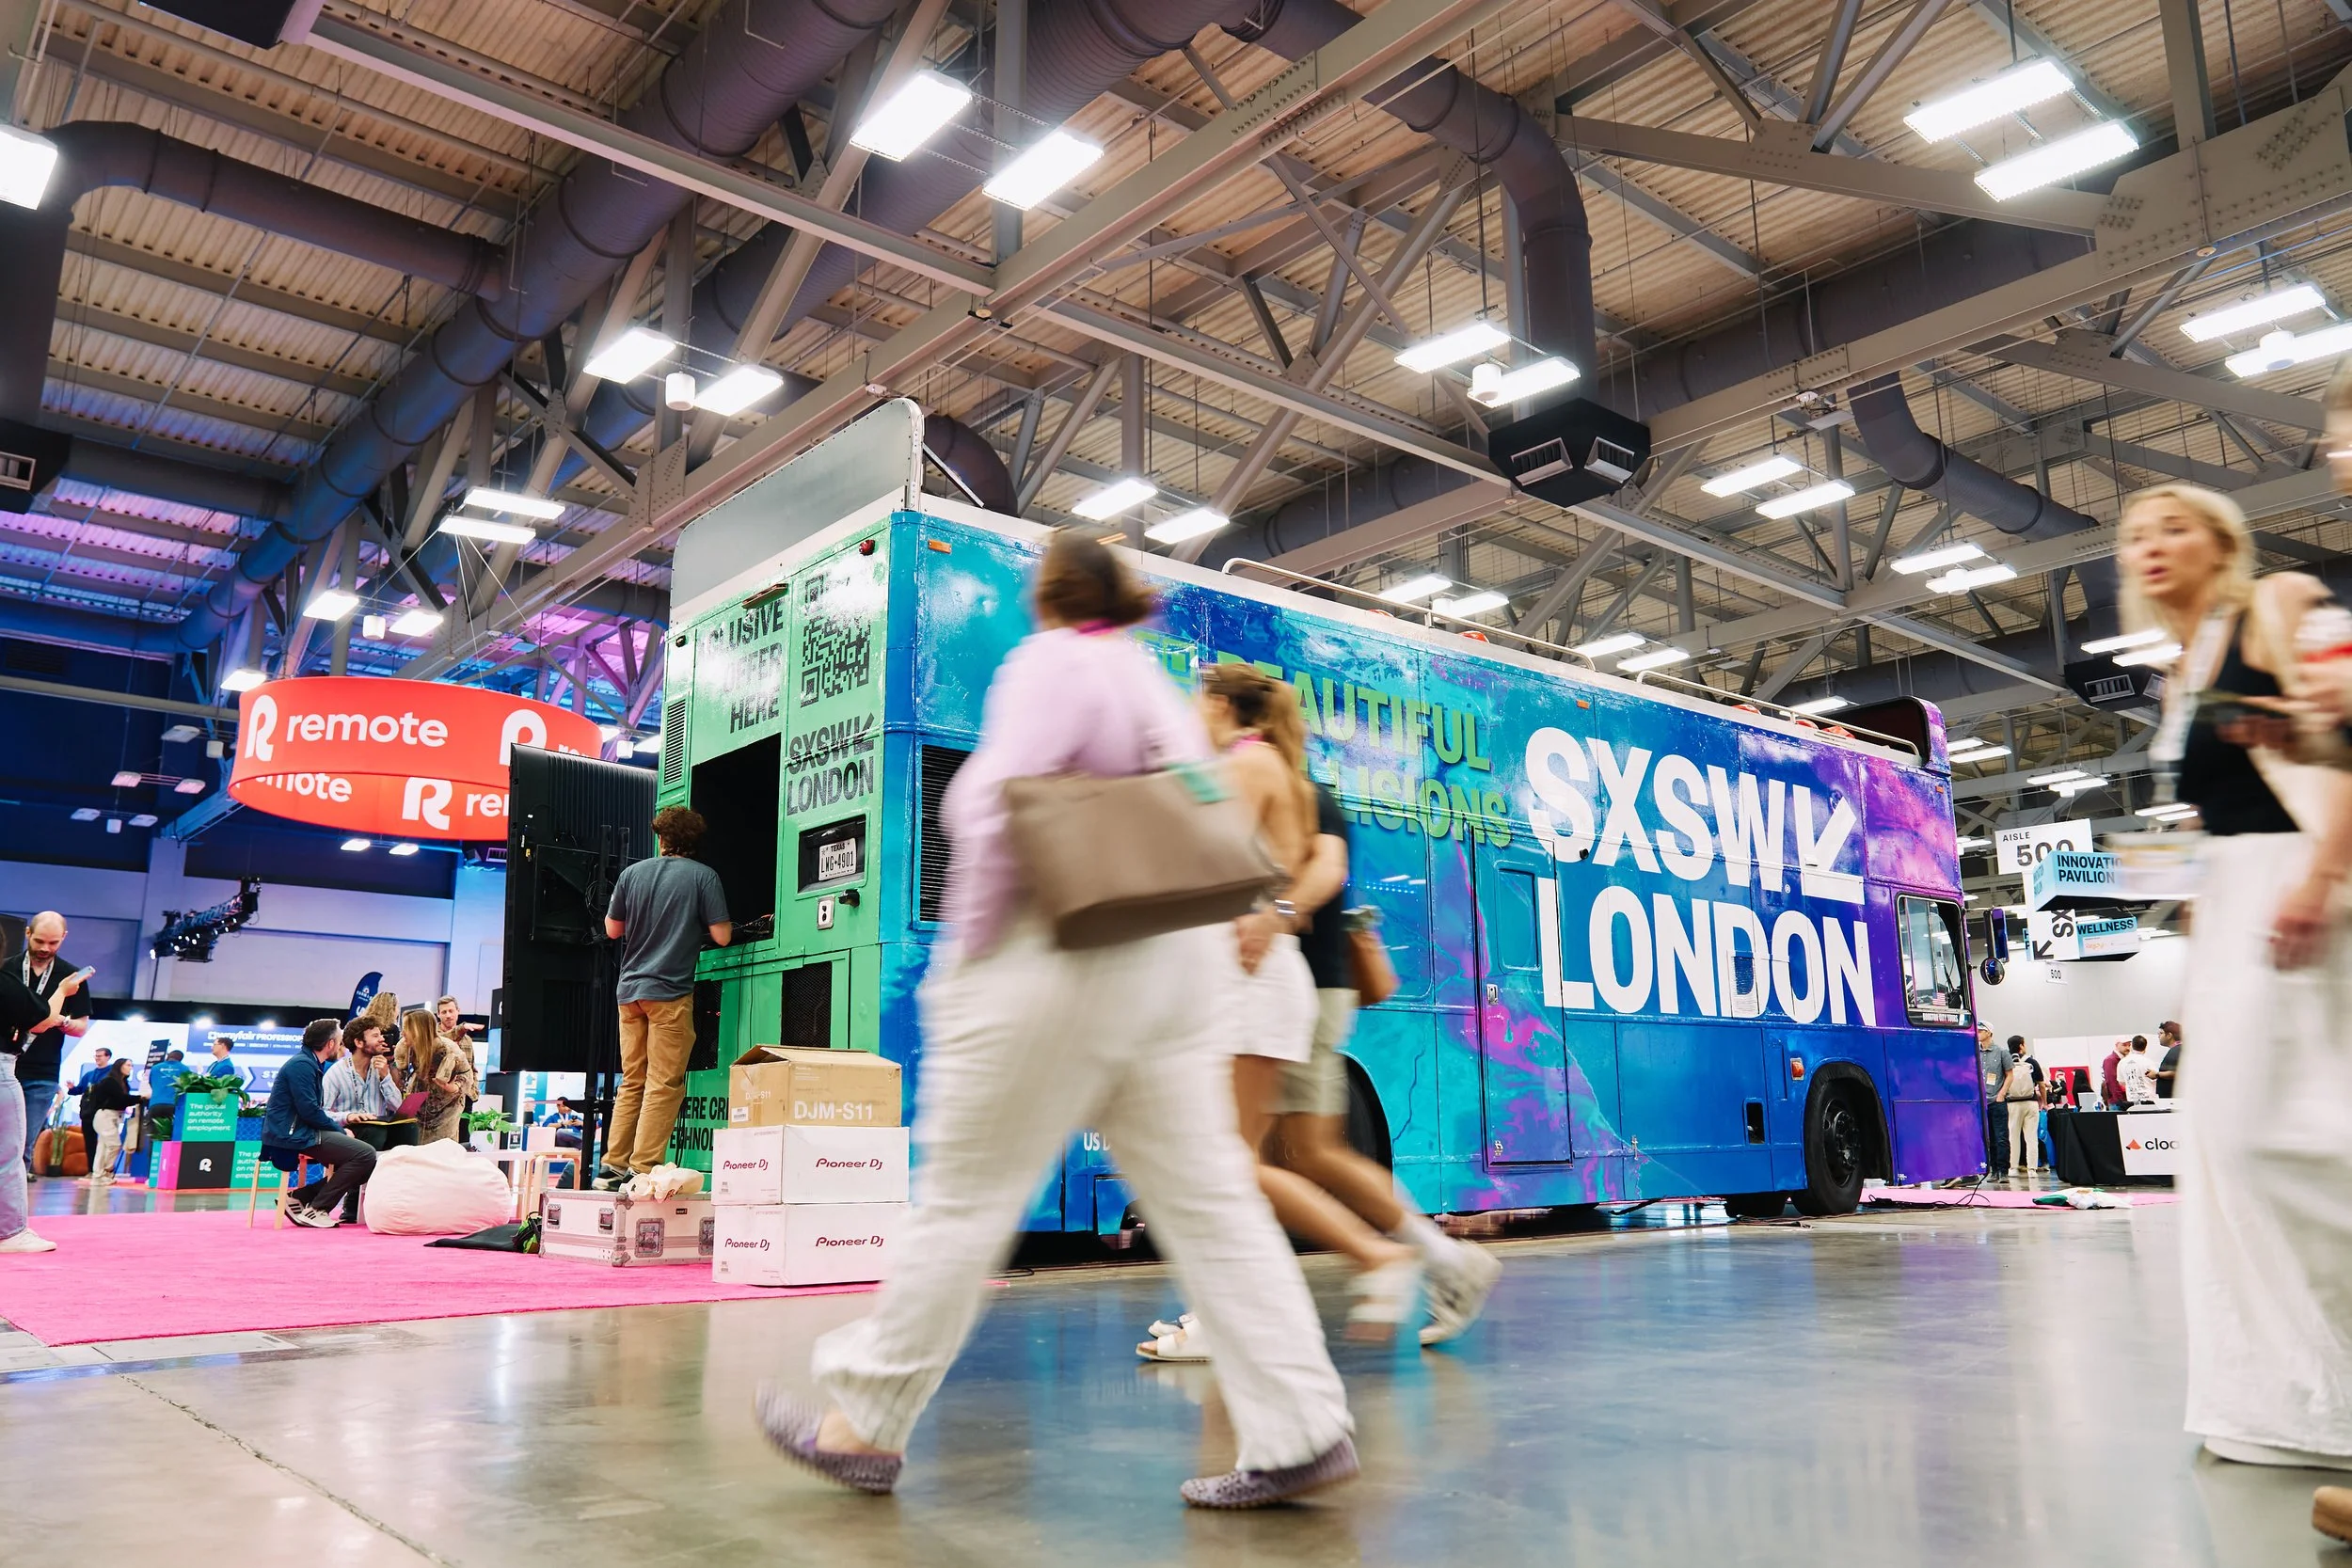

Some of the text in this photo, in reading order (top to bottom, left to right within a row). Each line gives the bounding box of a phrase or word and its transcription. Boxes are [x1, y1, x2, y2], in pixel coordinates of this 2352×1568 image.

[730, 694, 780, 734] HERE
[1216, 650, 1490, 771] AUTIFUL
[286, 711, 449, 748] remote
[787, 756, 875, 816] LONDON
[1298, 751, 1514, 847] LISIONS
[2002, 831, 2031, 843] AISLE
[831, 843, 846, 852] TEXAS
[2057, 855, 2122, 869] INNOVATIO
[2058, 870, 2116, 884] PAVILION
[2076, 919, 2134, 935] WELLNESS
[1538, 877, 1877, 1027] LONDON
[2050, 969, 2062, 980] 500
[794, 1101, 873, 1121] DJM-S11
[723, 1160, 757, 1170] Pioneer
[816, 1158, 867, 1169] Pioneer
[724, 1238, 758, 1249] Pioneer
[816, 1237, 867, 1247] Pioneer
